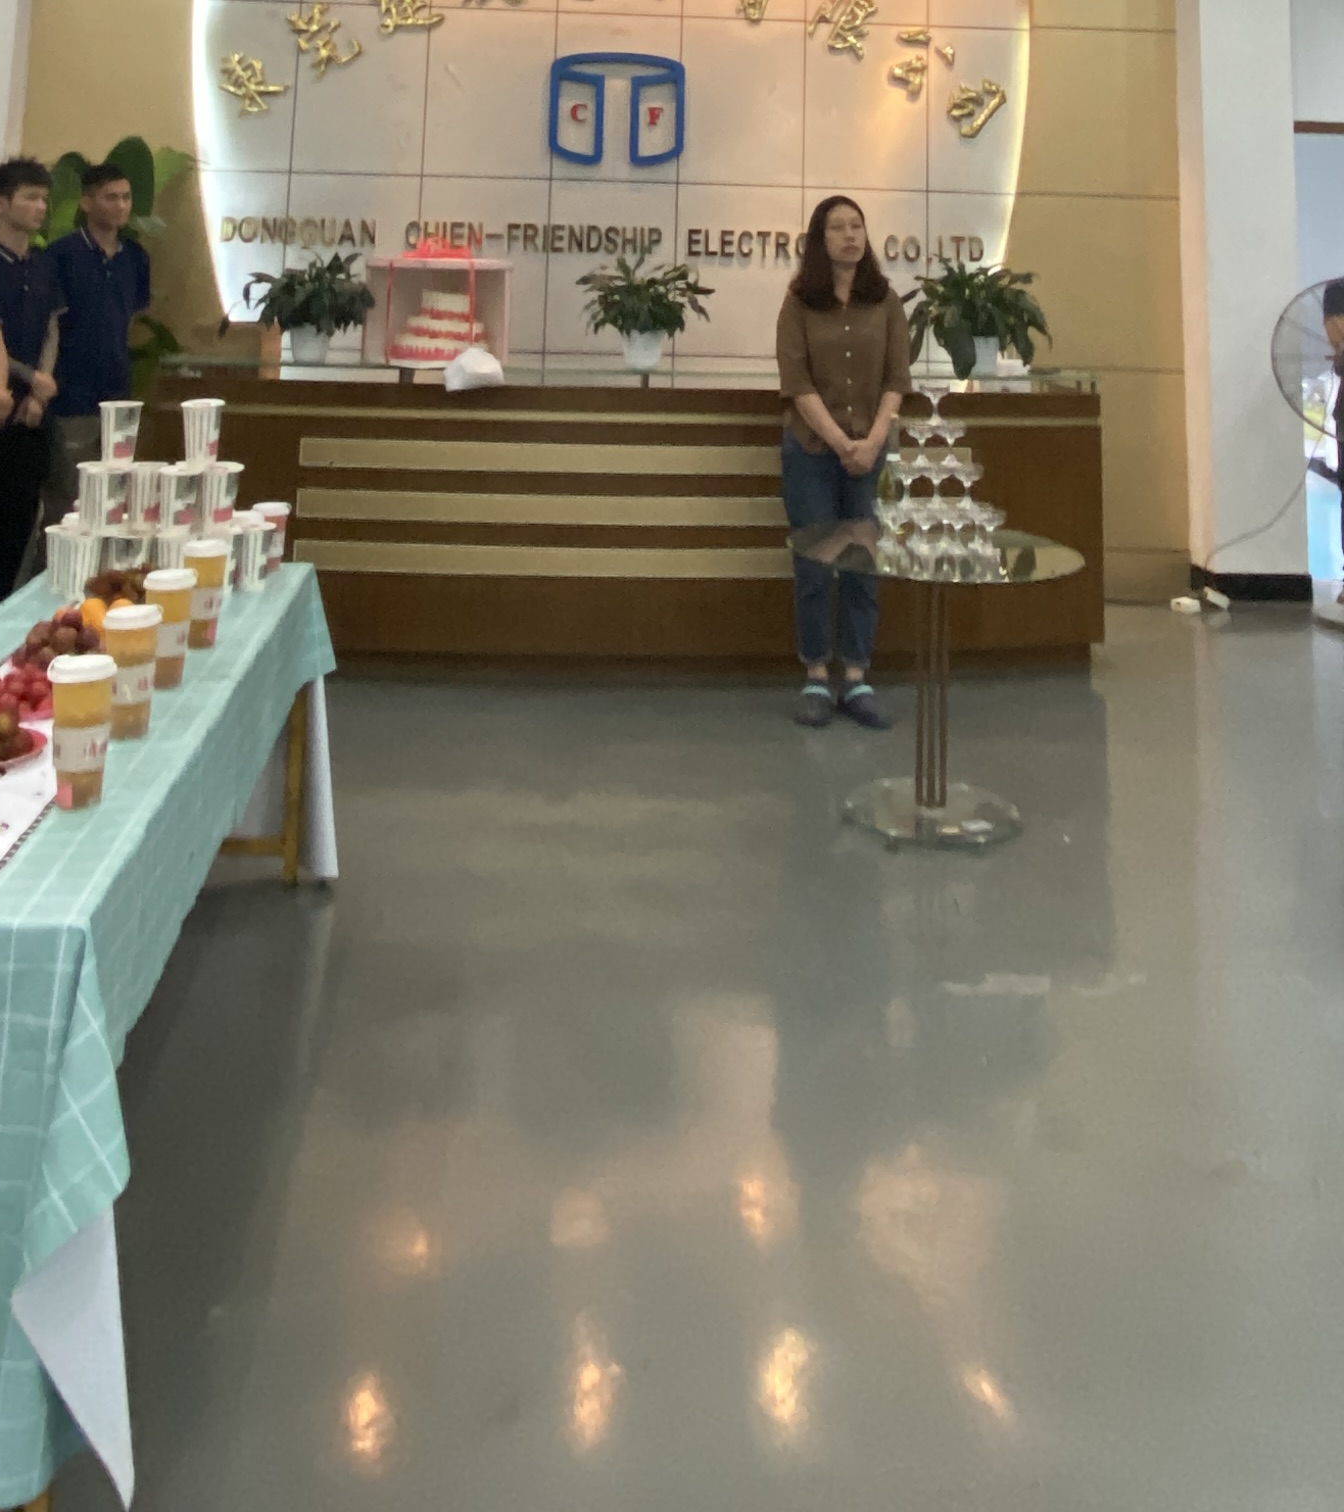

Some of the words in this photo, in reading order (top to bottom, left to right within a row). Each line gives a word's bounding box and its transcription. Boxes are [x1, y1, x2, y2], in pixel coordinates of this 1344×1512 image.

[569, 102, 588, 125] C
[646, 105, 666, 128] F
[404, 220, 664, 256] CHIEN-FRIENDSHIP
[687, 228, 808, 260] ELECTRO
